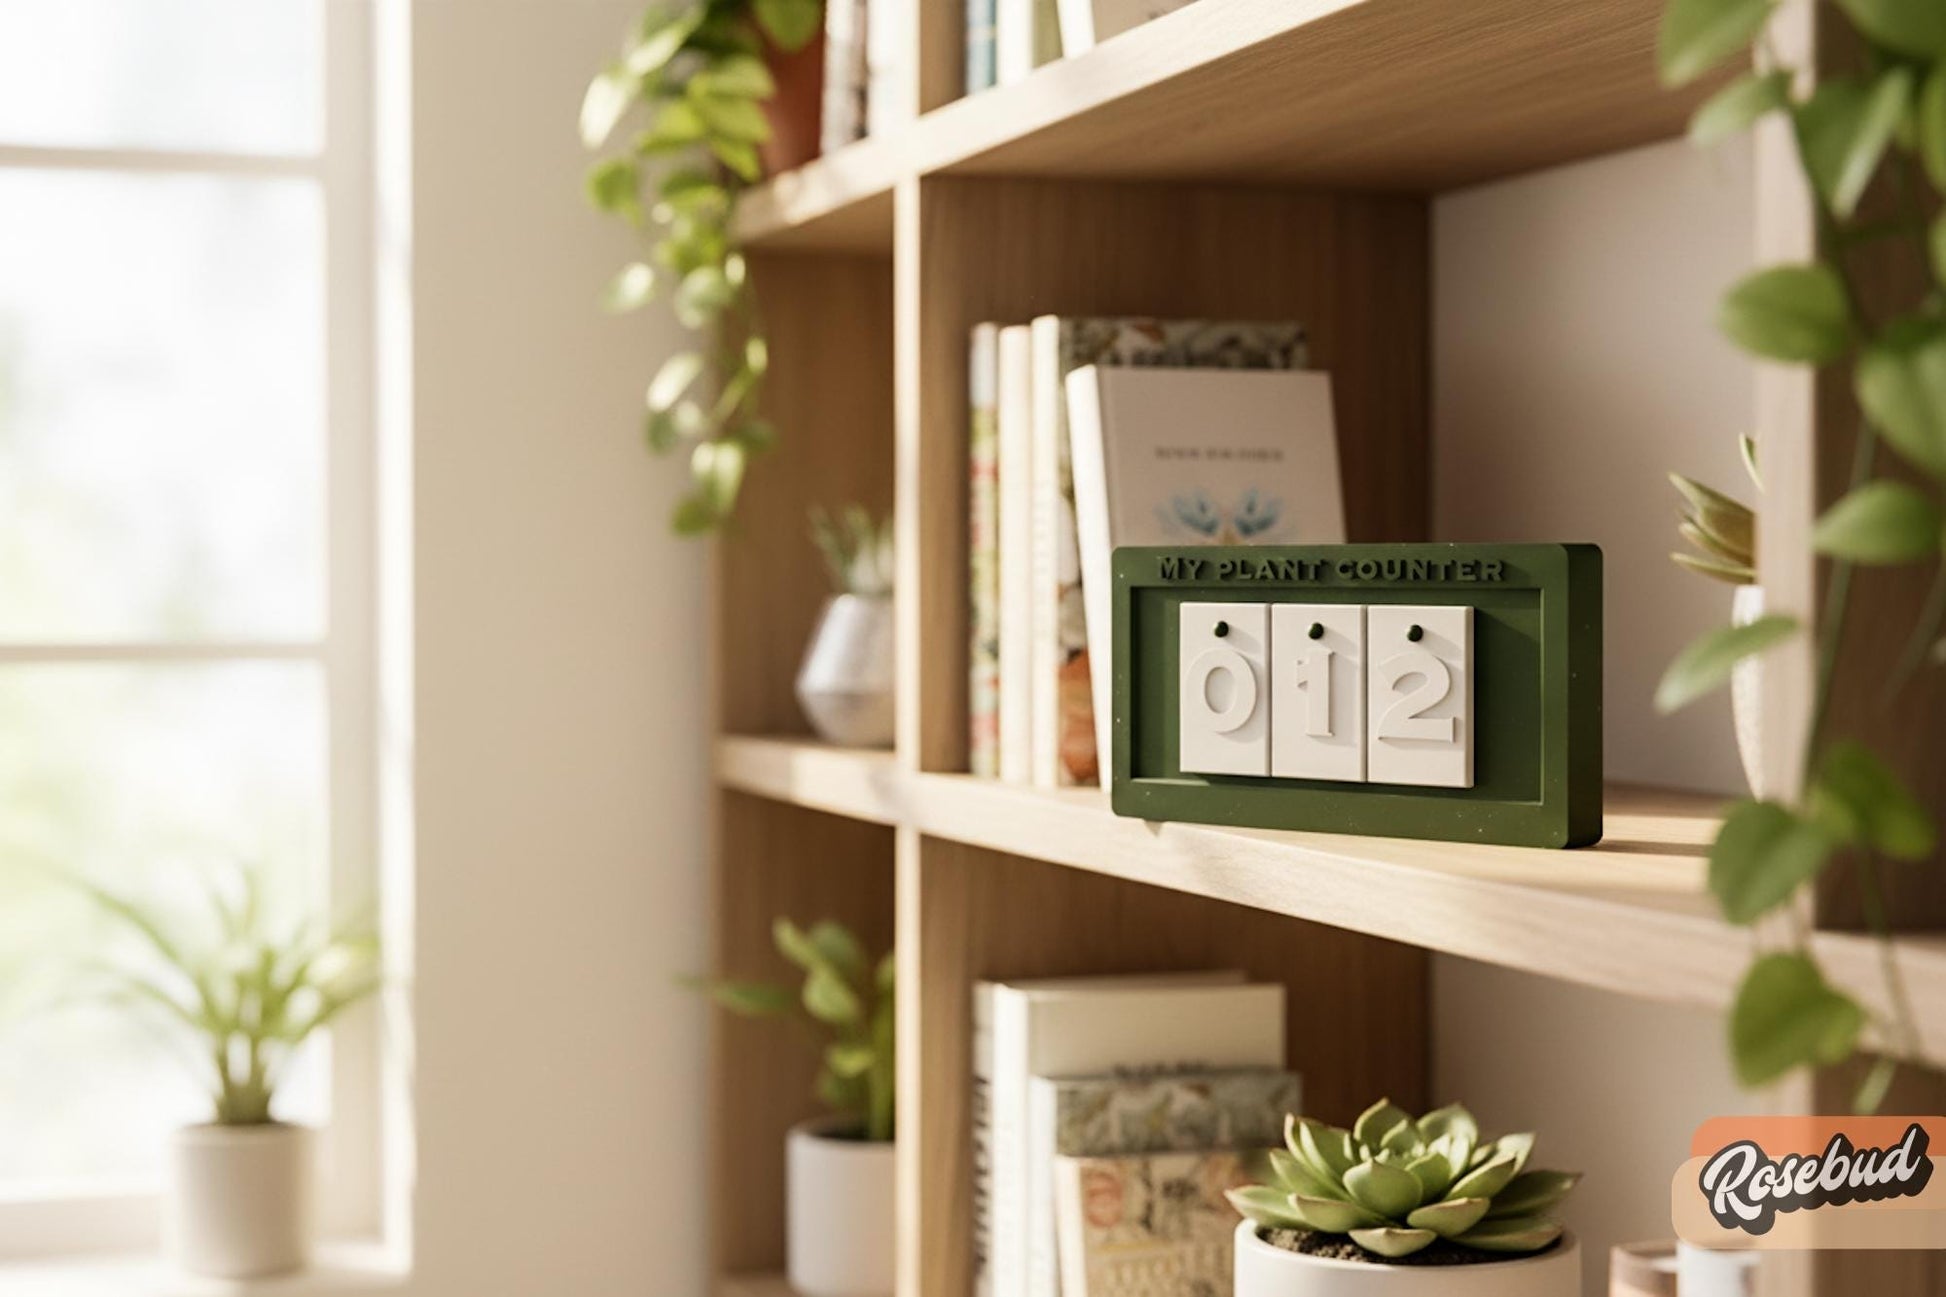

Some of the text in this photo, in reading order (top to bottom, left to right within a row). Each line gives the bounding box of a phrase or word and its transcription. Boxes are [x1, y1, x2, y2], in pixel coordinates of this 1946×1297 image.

[1158, 556, 1504, 582] MY PLANT COUNTER
